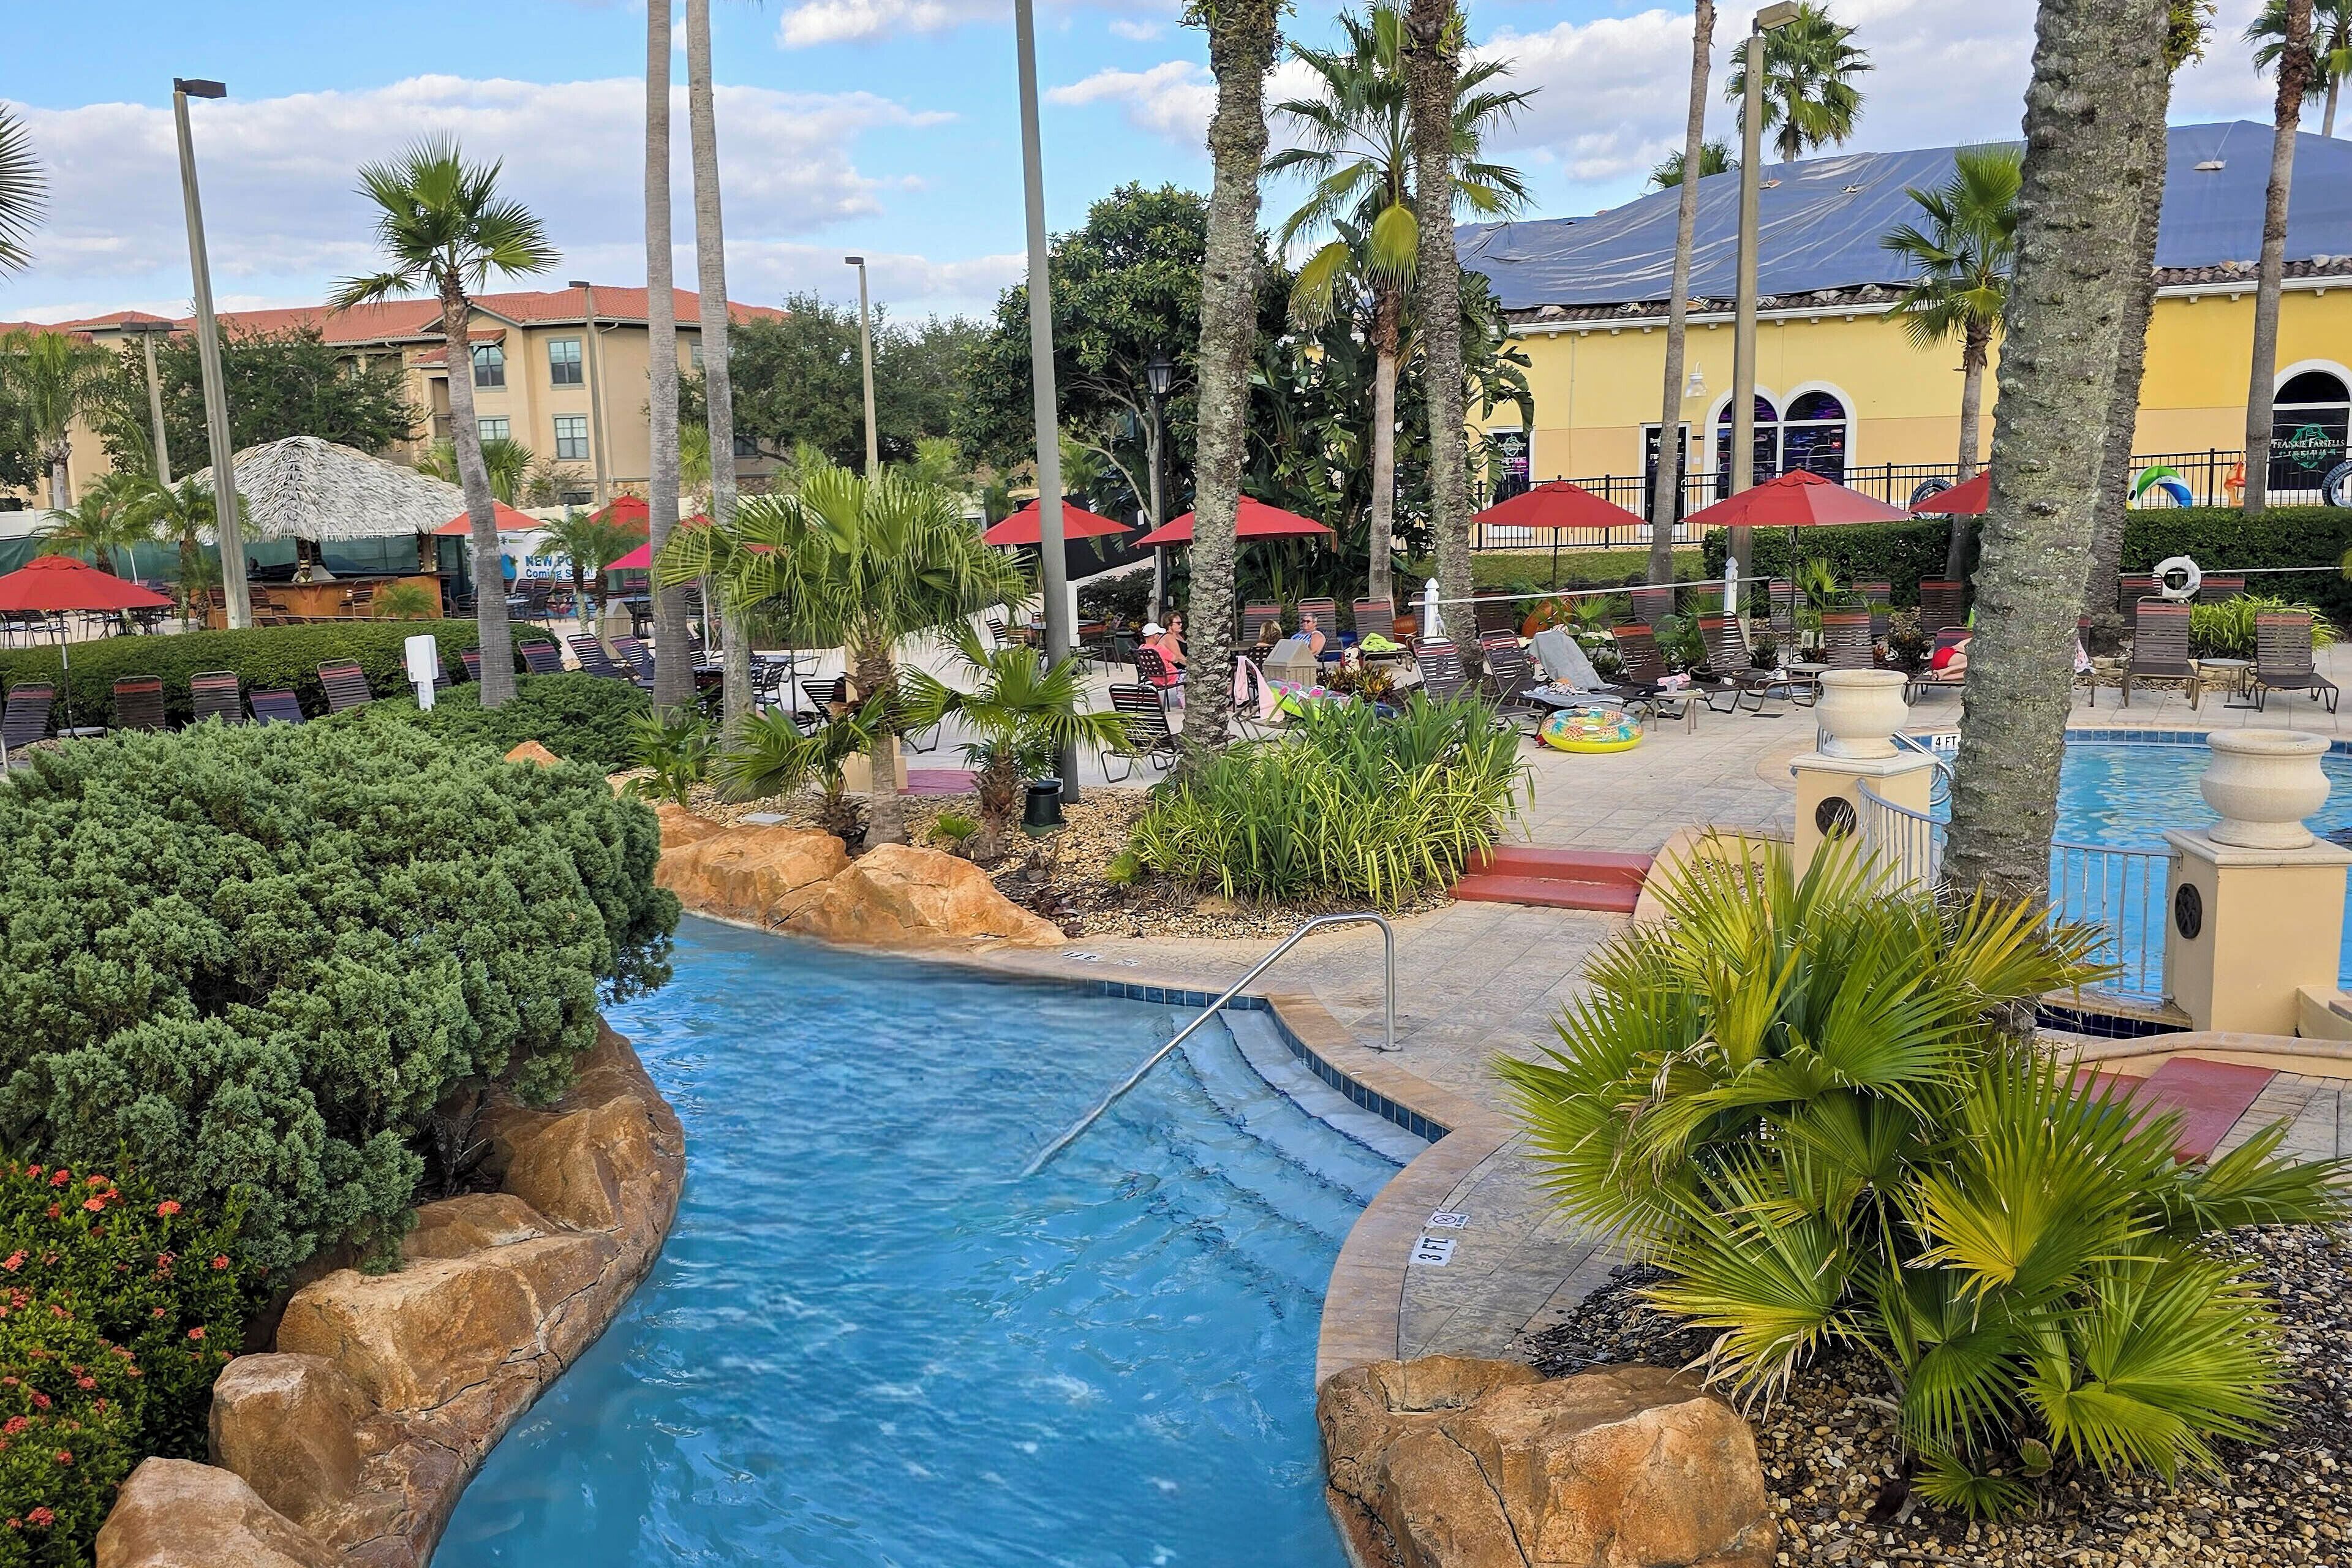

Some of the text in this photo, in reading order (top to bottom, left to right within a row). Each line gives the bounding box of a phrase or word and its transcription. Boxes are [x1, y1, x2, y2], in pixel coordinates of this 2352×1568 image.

[525, 555, 552, 567] NEW
[526, 568, 563, 581] Comig
[1936, 736, 1957, 746] 4 FT
